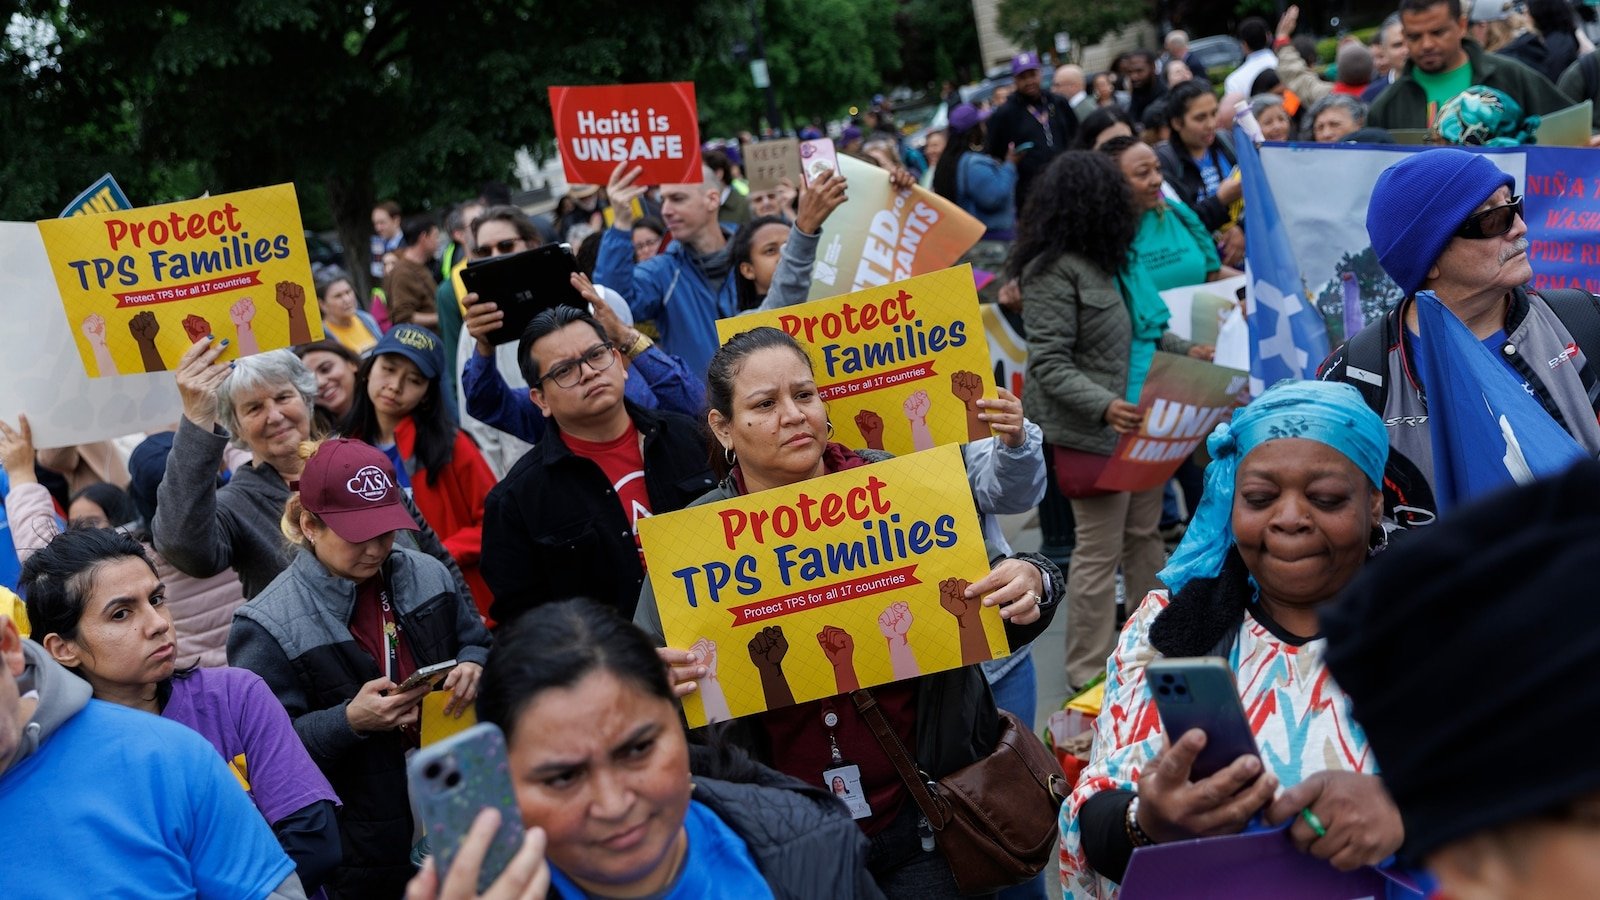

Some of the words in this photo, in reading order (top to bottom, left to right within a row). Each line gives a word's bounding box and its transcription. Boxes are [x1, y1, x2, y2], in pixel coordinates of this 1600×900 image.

[576, 108, 640, 135] Haiti
[647, 108, 670, 132] is
[571, 135, 683, 161] UNSAFE
[752, 144, 790, 161] KEEP
[757, 163, 788, 180] TPS
[1526, 170, 1586, 198] NIÑA
[103, 202, 242, 252] Protect
[67, 254, 139, 292] TPS
[147, 231, 291, 282] Families
[1529, 239, 1576, 263] PIDE
[124, 292, 156, 305] Protect
[156, 289, 175, 300] TPS
[175, 288, 188, 297] for
[189, 286, 200, 295] all
[201, 283, 211, 293] 17
[212, 276, 252, 291] countries
[778, 289, 916, 343] Protect
[821, 319, 967, 377] Families
[828, 384, 847, 397] TPS
[847, 381, 861, 392] for
[862, 379, 873, 389] all
[874, 376, 885, 387] 17
[885, 366, 926, 383] countries
[346, 473, 394, 494] CASA
[717, 475, 891, 550] Protect
[671, 554, 762, 608] TPS
[773, 513, 958, 586] Families
[743, 602, 784, 619] Protect
[784, 595, 807, 609] TPS
[807, 592, 823, 604] for
[825, 588, 838, 600] all
[840, 584, 853, 597] 17
[855, 573, 906, 593] countries
